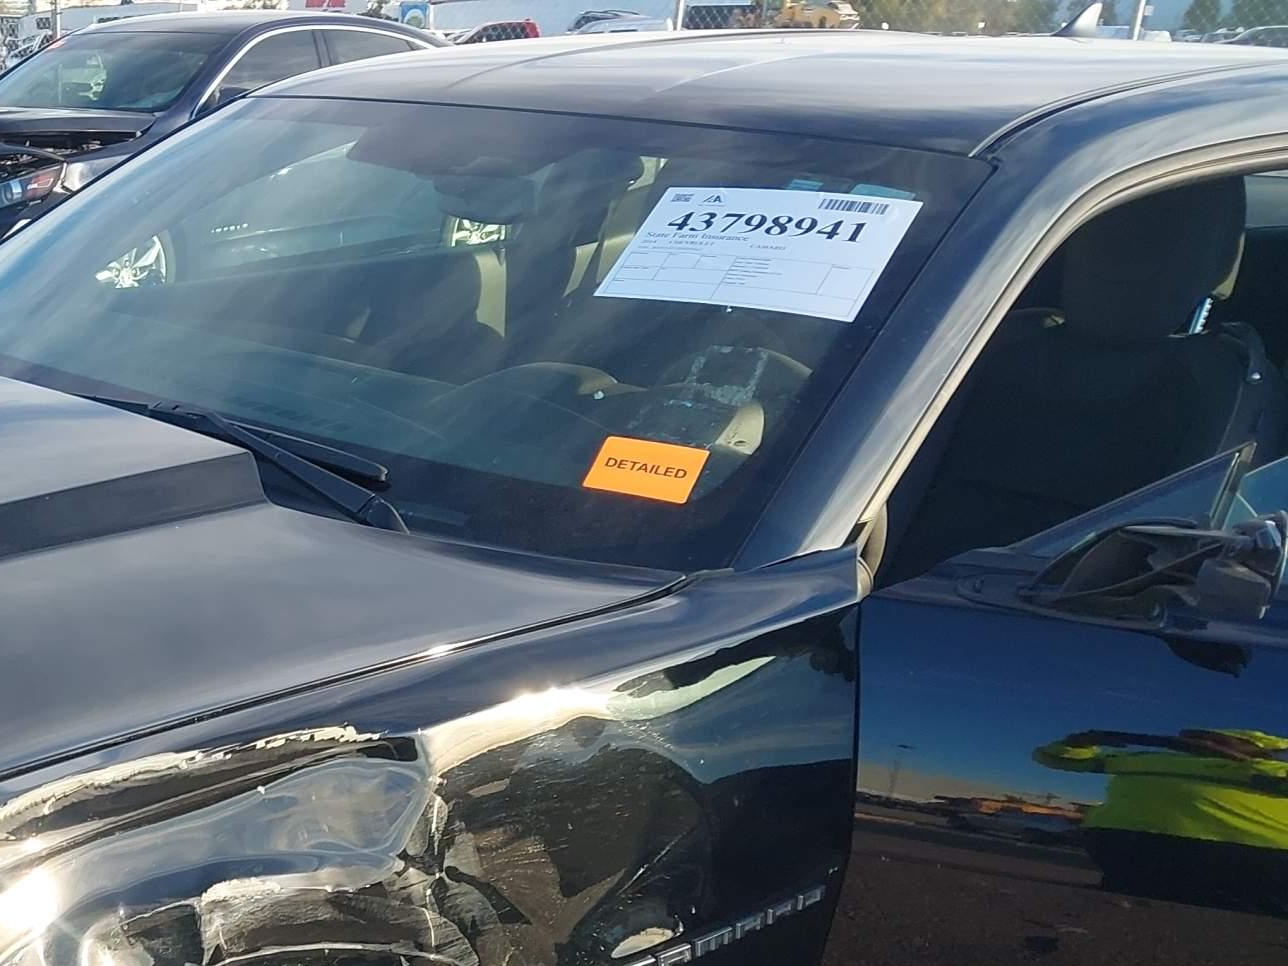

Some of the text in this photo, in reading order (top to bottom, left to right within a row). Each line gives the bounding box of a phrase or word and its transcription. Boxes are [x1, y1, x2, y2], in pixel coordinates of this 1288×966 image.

[646, 231, 750, 242] State Farm Insurance
[667, 211, 867, 242] 43798941
[604, 457, 688, 479] DETAILED
